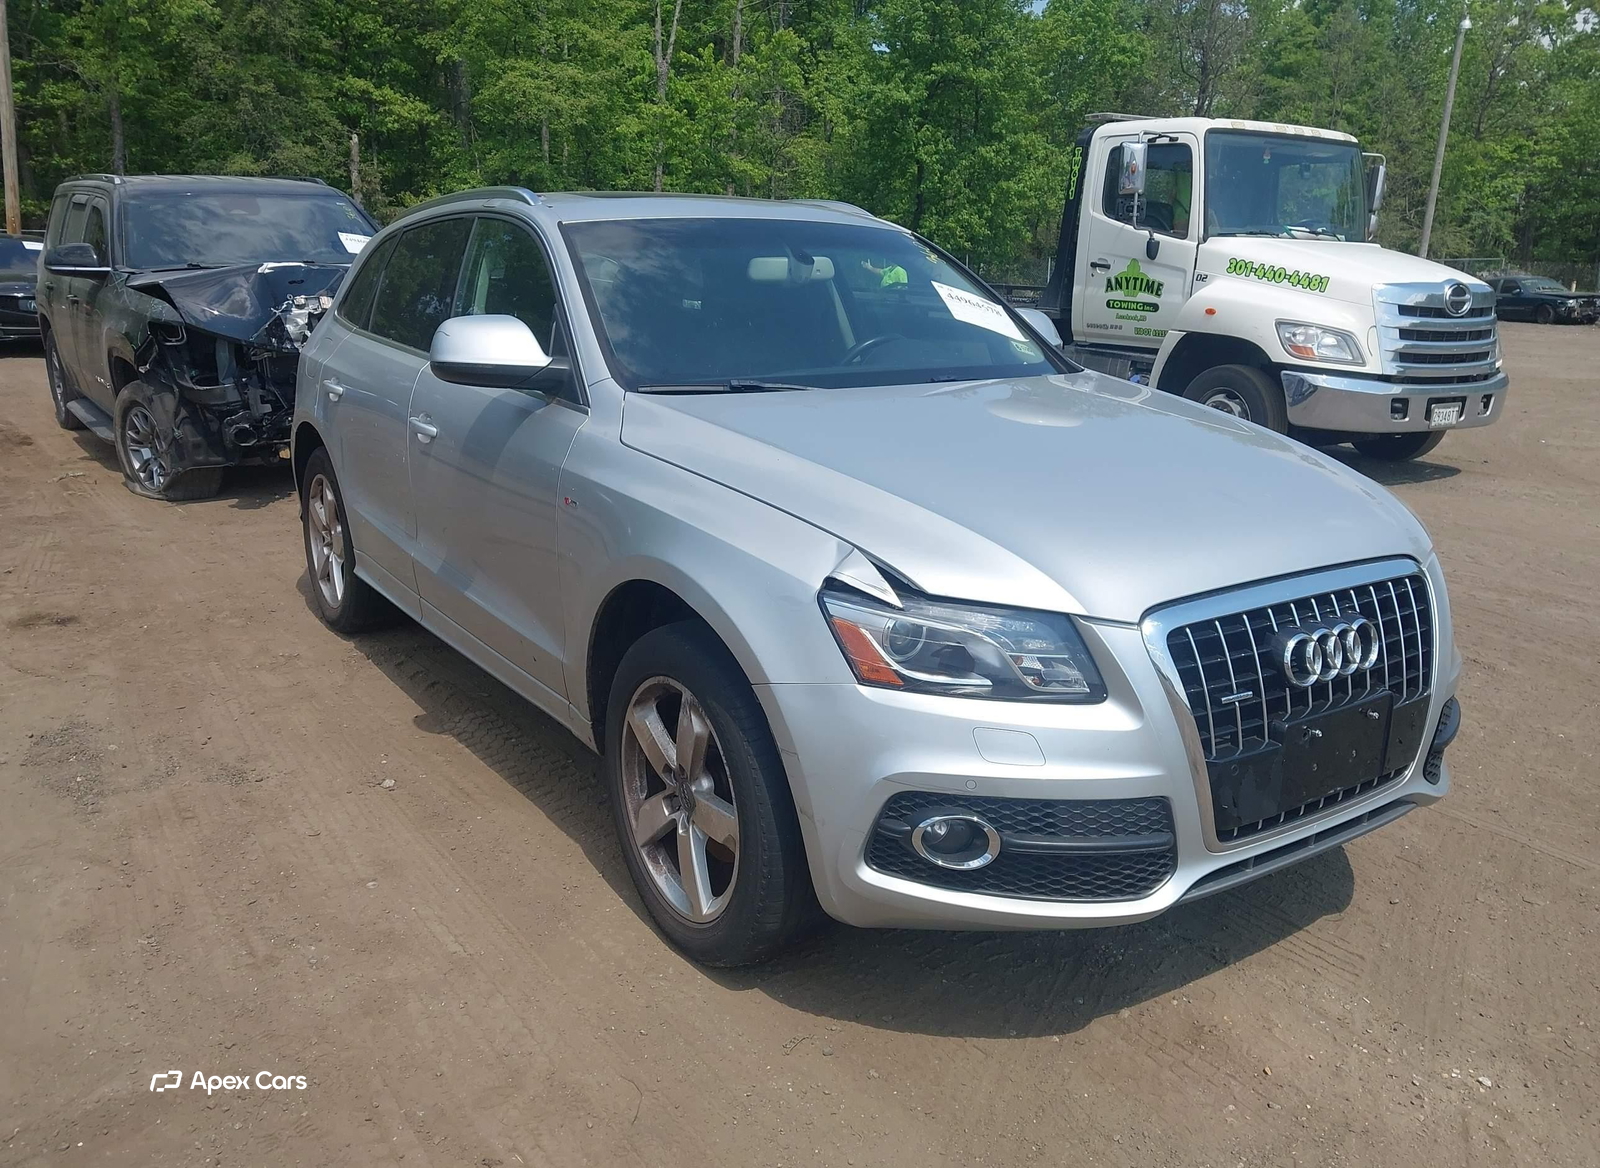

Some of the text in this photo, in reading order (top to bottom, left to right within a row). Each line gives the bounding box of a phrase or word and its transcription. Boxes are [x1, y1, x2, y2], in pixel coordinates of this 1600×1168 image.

[1195, 274, 1208, 282] 02
[1226, 258, 1330, 292] 301-440-4481
[1105, 276, 1164, 298] ANYTIME
[1109, 301, 1143, 310] TOWING
